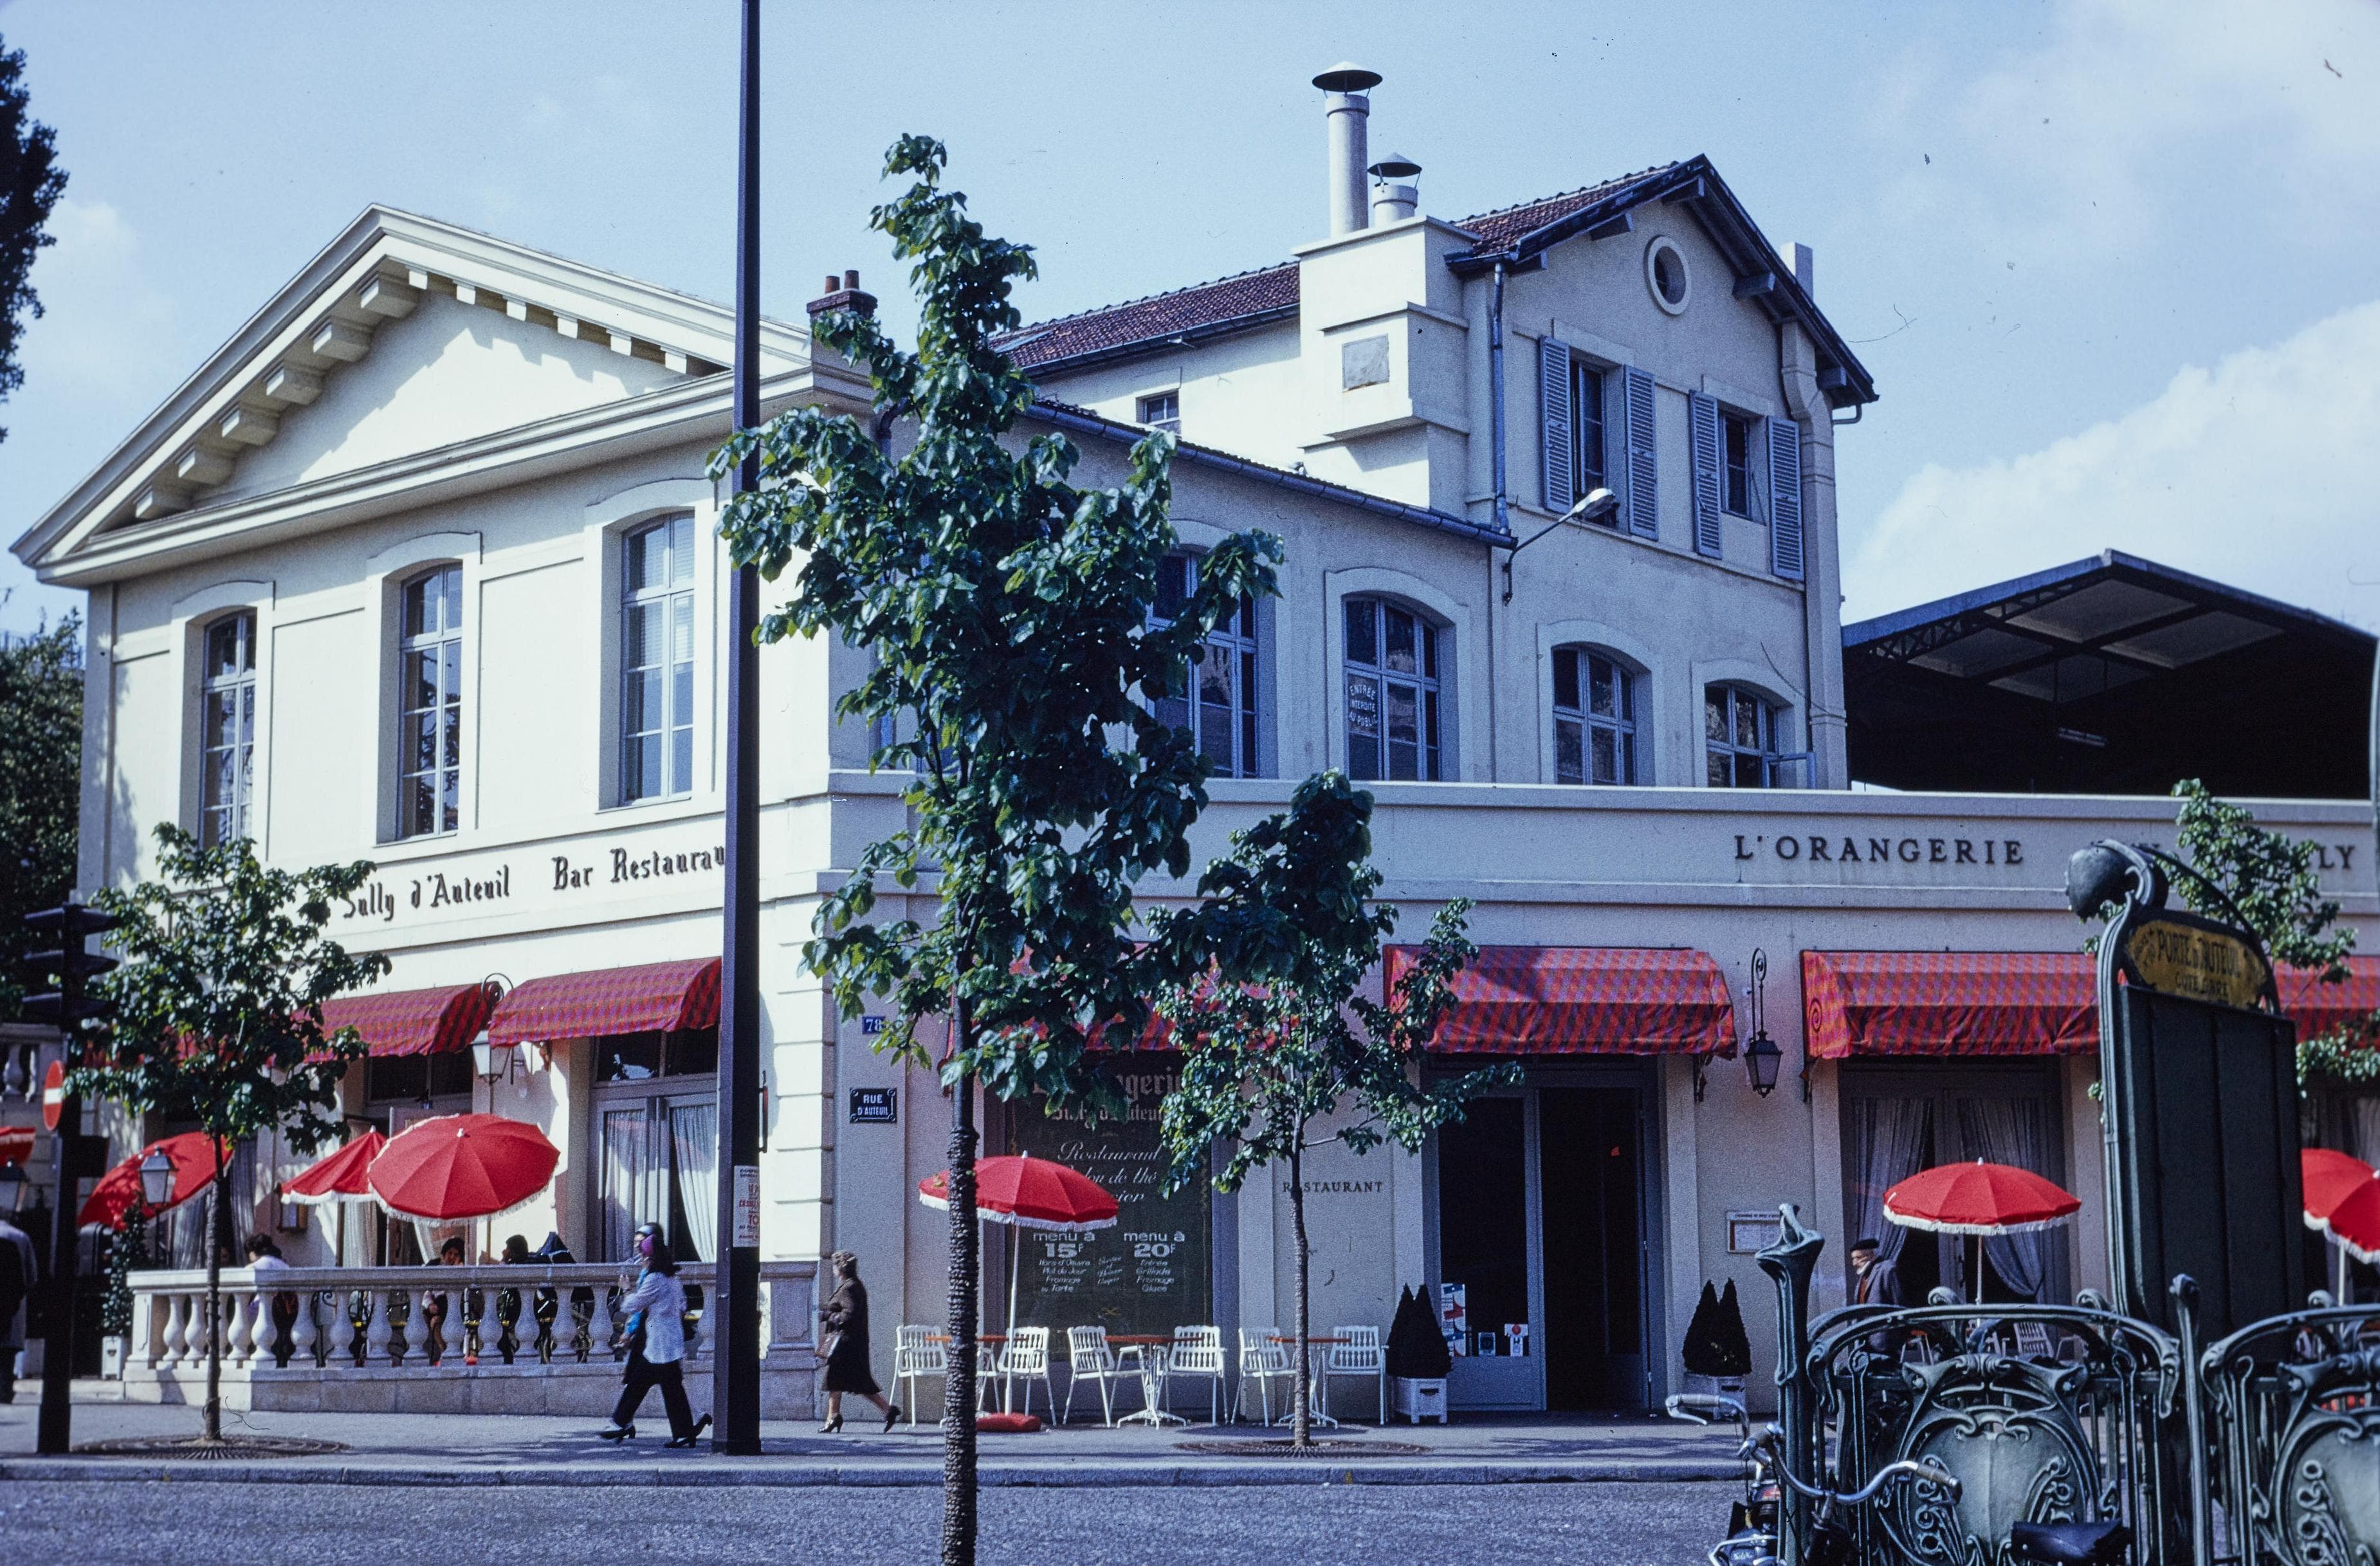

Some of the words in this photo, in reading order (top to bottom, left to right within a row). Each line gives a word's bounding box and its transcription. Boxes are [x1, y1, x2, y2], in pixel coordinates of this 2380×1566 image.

[1735, 834, 2024, 865] L'ORANGERIE
[551, 855, 593, 891] Bar
[410, 864, 509, 908] d'Auteuil
[865, 1018, 882, 1032] 78
[863, 1094, 883, 1105] RUE
[857, 1106, 889, 1117] D'AUTEUIL
[1058, 1141, 1163, 1161] Restaurant
[1283, 1181, 1383, 1193] RSTAURANT
[1032, 1231, 1077, 1242] menu
[1124, 1232, 1169, 1242] menu
